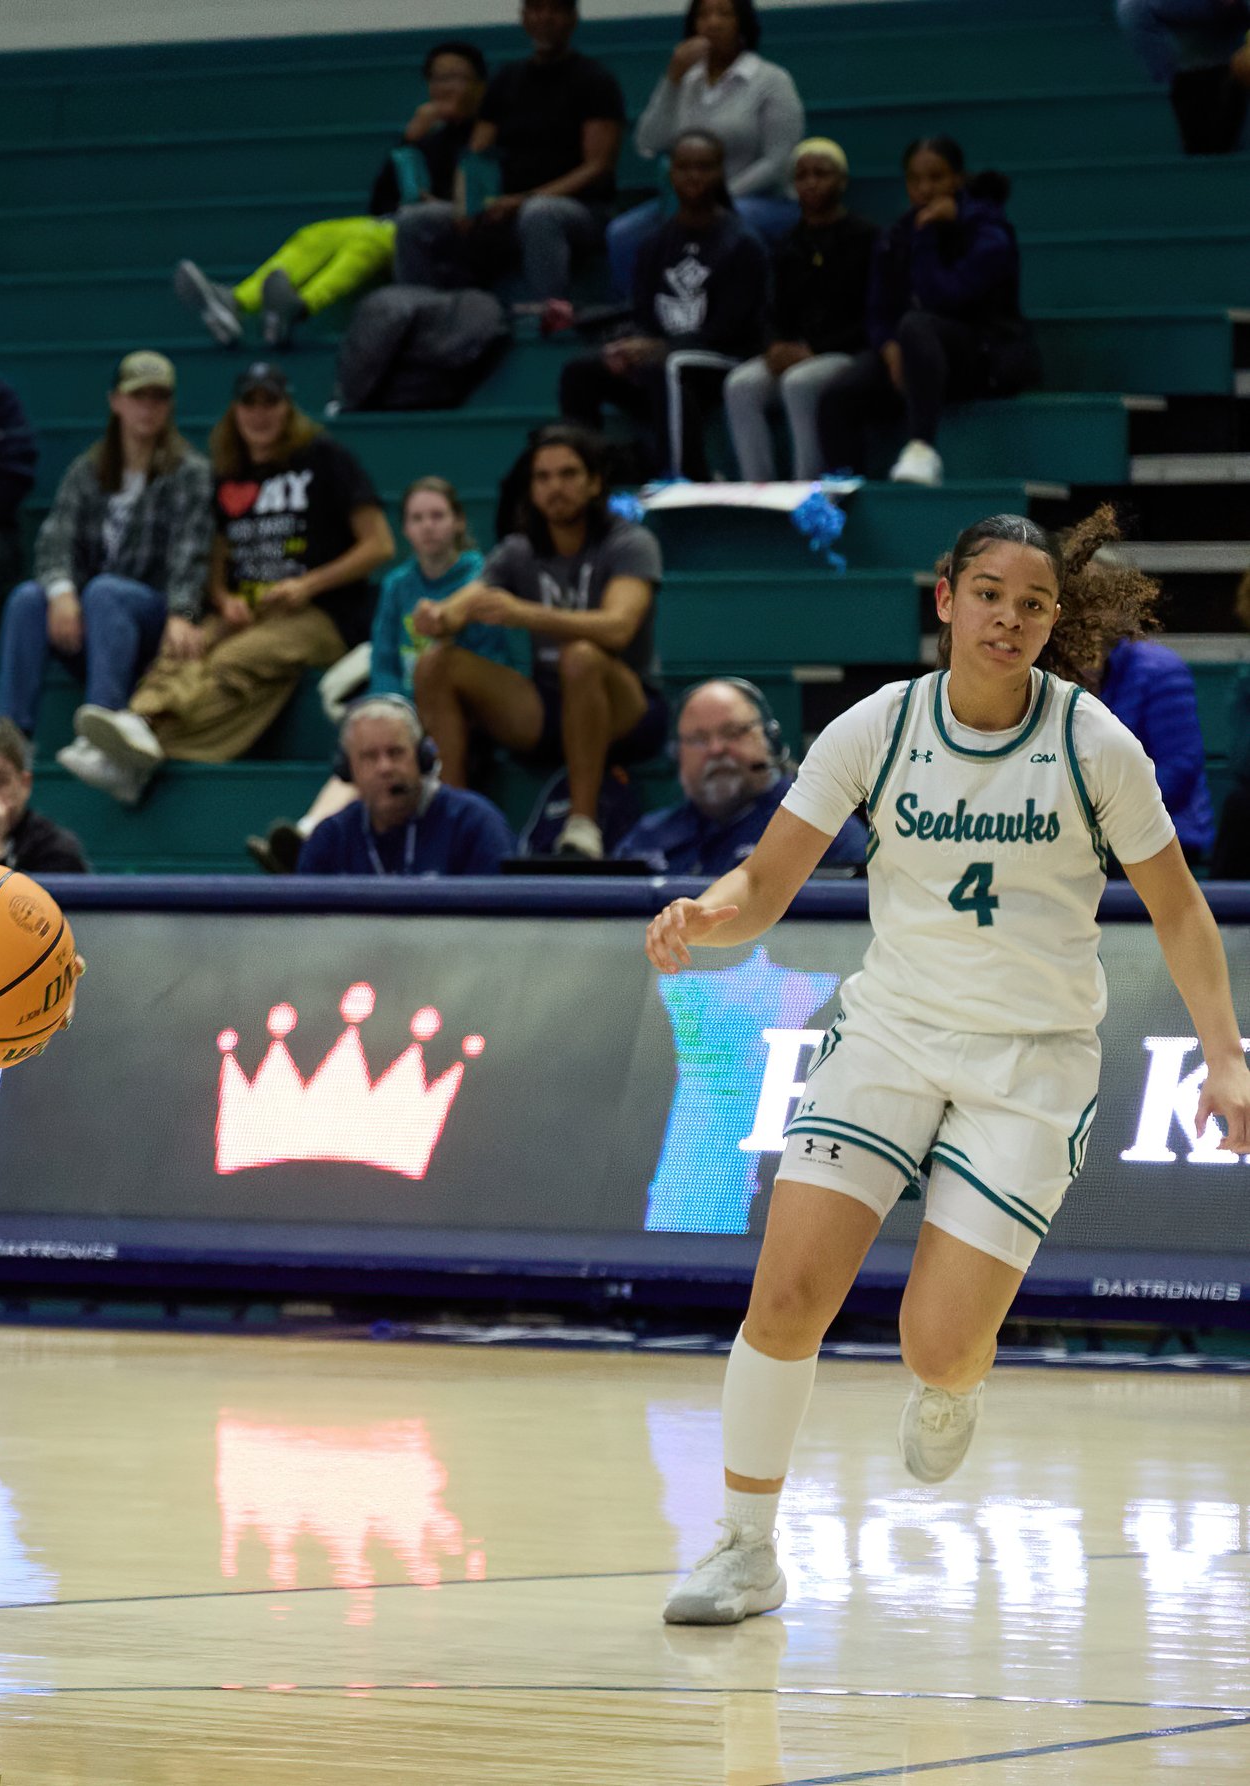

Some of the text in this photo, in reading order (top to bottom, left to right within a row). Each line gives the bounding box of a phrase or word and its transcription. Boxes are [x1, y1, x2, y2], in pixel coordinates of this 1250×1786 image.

[1030, 752, 1058, 764] CAA
[895, 792, 1061, 844] Seahawks
[948, 862, 1000, 928] 4
[1092, 1277, 1242, 1302] DAKTRONICS
